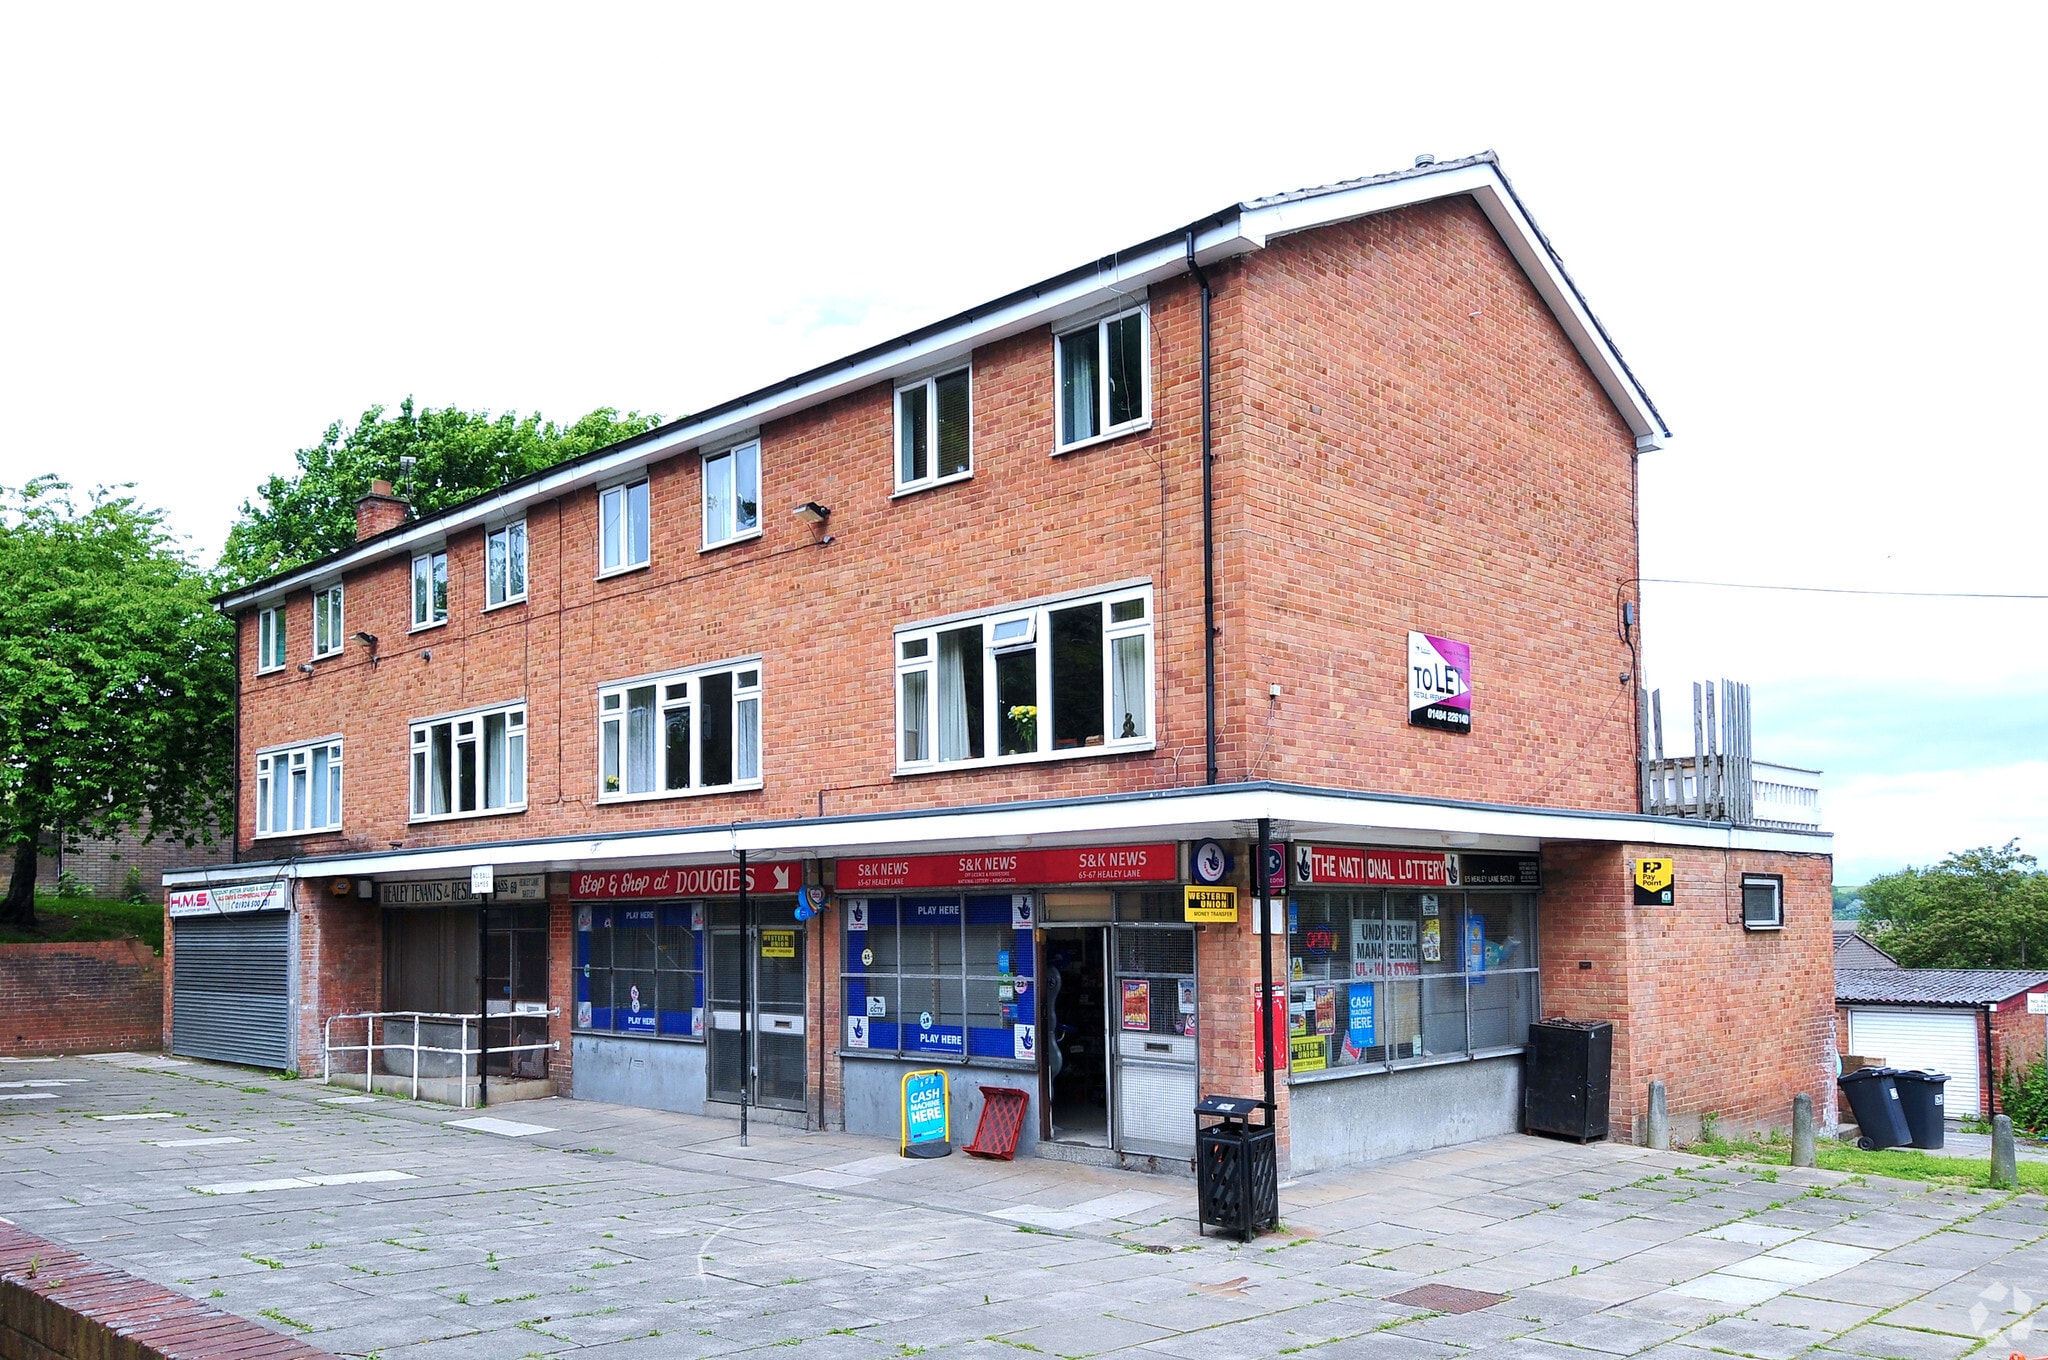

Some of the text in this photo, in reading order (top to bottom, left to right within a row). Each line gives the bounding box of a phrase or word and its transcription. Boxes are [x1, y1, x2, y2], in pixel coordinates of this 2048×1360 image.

[1413, 663, 1463, 695] TO LET
[1427, 708, 1447, 720] 01484
[958, 856, 1017, 871] S&K NEWS
[1078, 851, 1147, 868] S&K NEWS
[858, 861, 909, 876] S&K NEWS
[1078, 869, 1141, 879] 65-67 HEALEY LANE
[1312, 854, 1446, 881] THE NATIONAL LOTTERY
[578, 867, 755, 896] Stop & Shop at DOUGIES
[872, 878, 890, 886] HEALEY
[891, 877, 904, 885] LANE
[1471, 875, 1487, 883] HEALEY
[1487, 875, 1500, 883] LANE
[1500, 875, 1516, 883] BATLEY
[383, 884, 409, 903] HEALEY
[411, 883, 443, 902] TENANTS
[1188, 892, 1227, 901] WESTERN
[170, 892, 210, 908] H.M.S.
[1200, 900, 1227, 908] UNION
[626, 911, 654, 919] PLAY HERE
[917, 905, 959, 915] PLAY HERE
[1361, 924, 1413, 941] UNDR NEW
[1356, 943, 1418, 960] MANAEMENT
[1355, 962, 1368, 977] UL
[1350, 996, 1373, 1009] CASH
[1351, 1008, 1372, 1016] MACHINE
[627, 1016, 655, 1026] PLAY HERE
[1350, 1016, 1373, 1029] HERE
[920, 1033, 962, 1045] PLAY HERE
[1297, 1050, 1319, 1059] UNION
[910, 1088, 940, 1103] CASH
[910, 1099, 940, 1112] MACHINE
[911, 1107, 942, 1124] HERE
